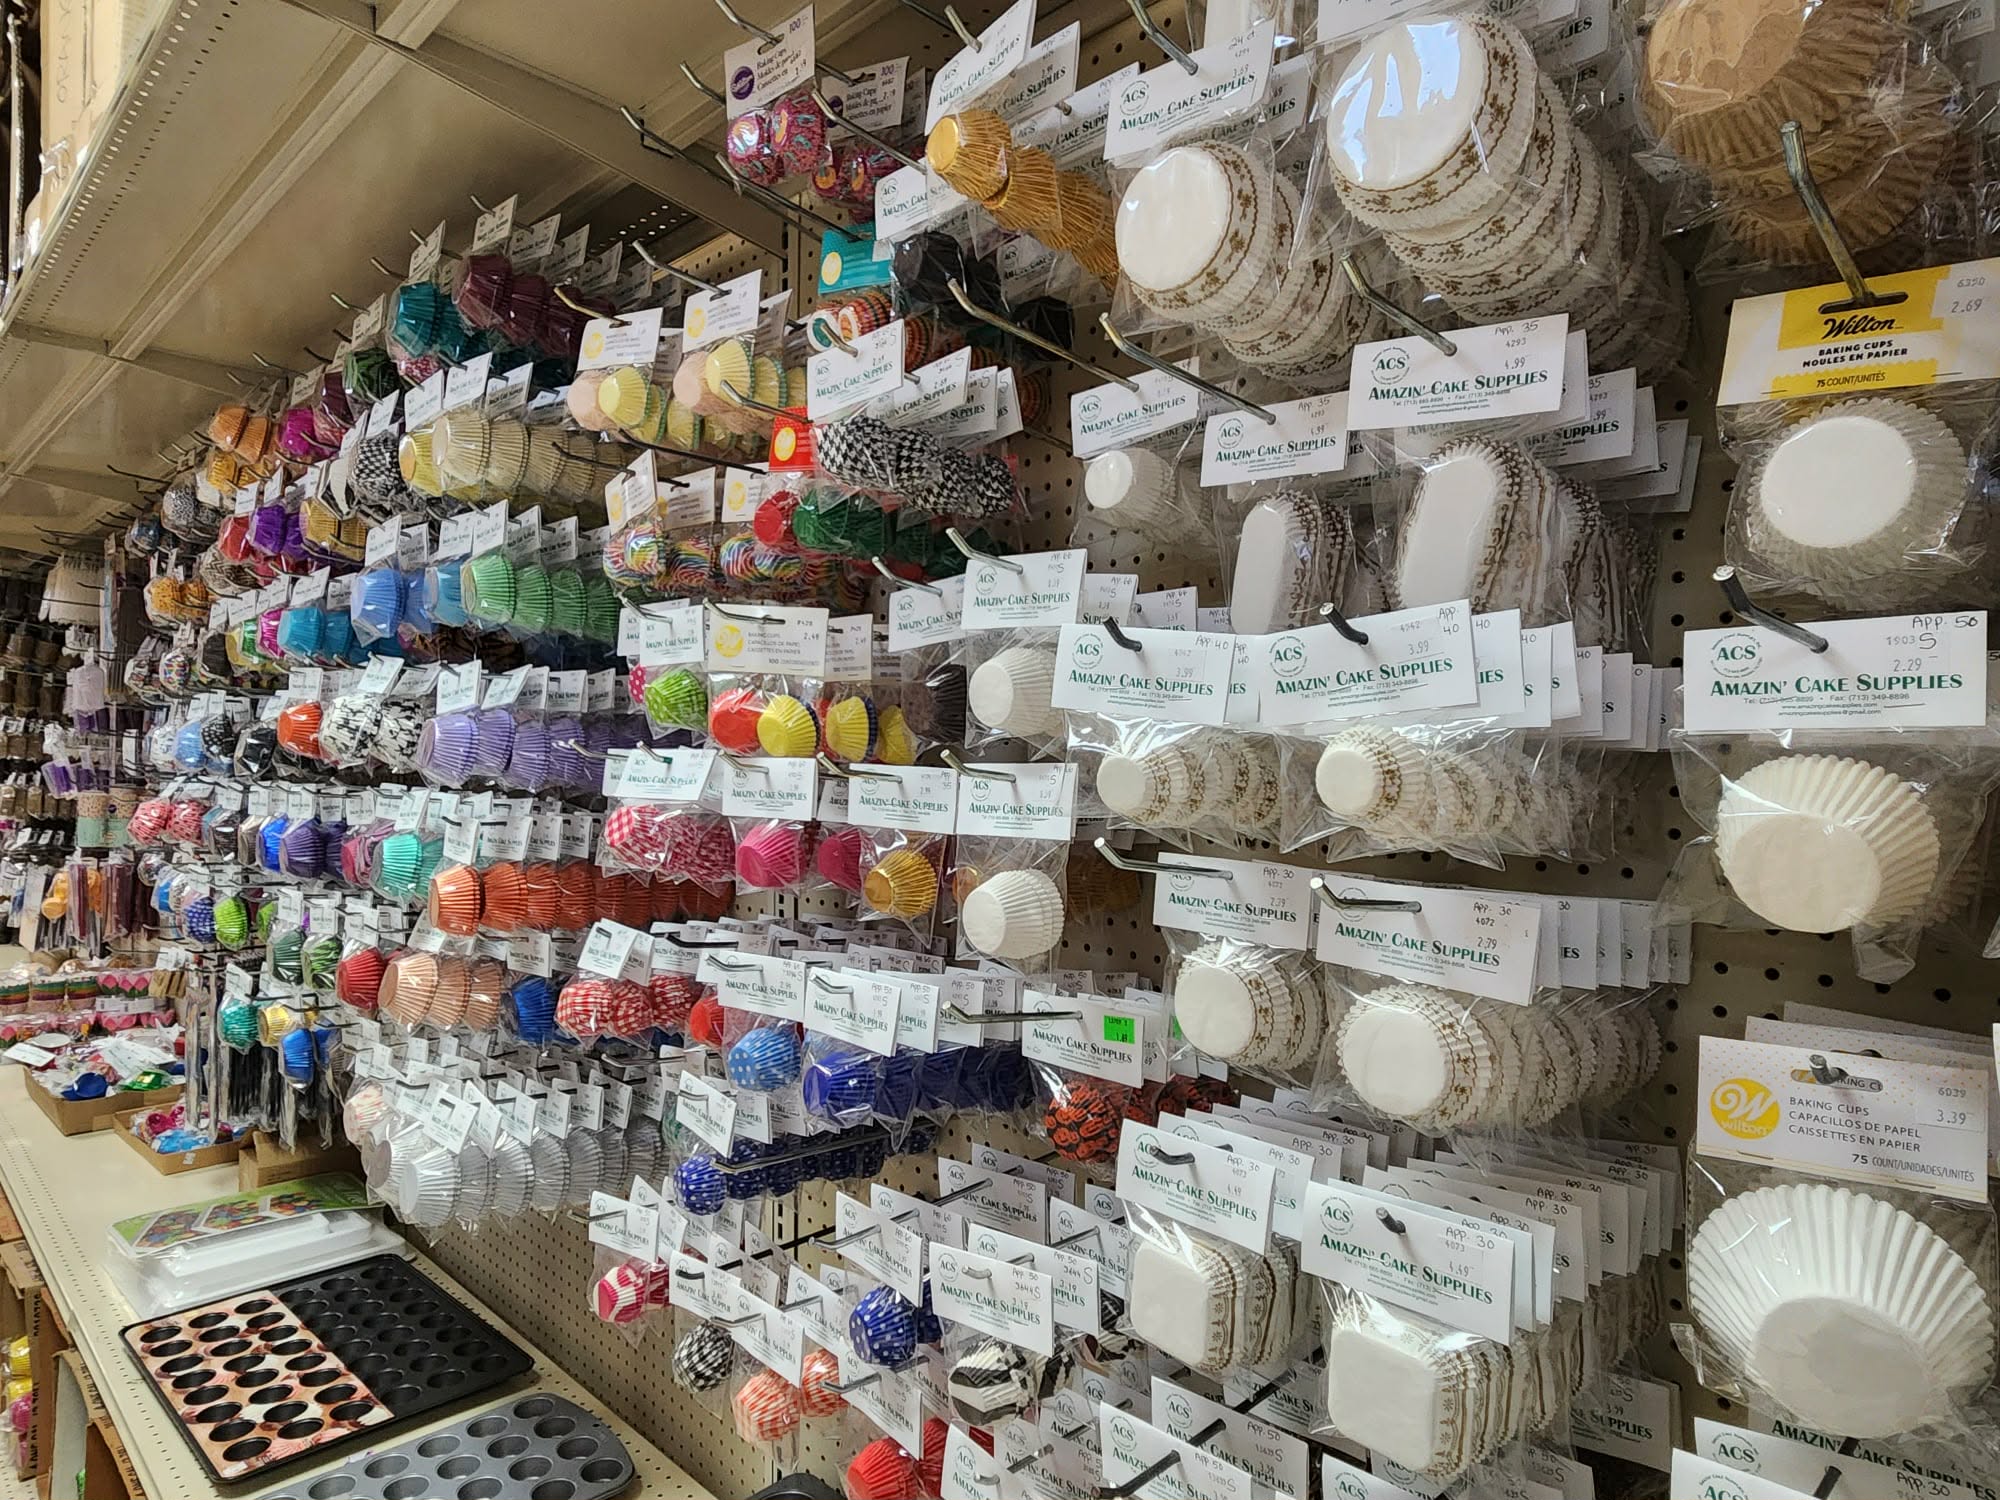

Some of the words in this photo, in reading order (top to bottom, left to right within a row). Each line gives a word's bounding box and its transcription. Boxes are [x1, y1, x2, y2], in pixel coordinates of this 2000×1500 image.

[1123, 87, 1147, 104] ACS
[1167, 95, 1195, 115] CAKE
[1199, 73, 1255, 101] SUPPLIES
[1951, 299, 1982, 313] 2.69
[1522, 320, 1539, 332] 35
[1821, 314, 1896, 339] Wilton
[1819, 345, 1860, 356] BAKING
[1864, 339, 1893, 350] CUPS
[1376, 357, 1406, 370] ACS
[1802, 356, 1844, 368] MOULES
[1849, 352, 1864, 361] EN
[1867, 347, 1908, 360] PAPIER
[1369, 385, 1427, 400] AMAZIN'
[1431, 380, 1470, 395] CAKE
[1474, 370, 1549, 390] SUPPLIES
[1816, 378, 1826, 388] 75
[1827, 371, 1885, 387] COUNT/UNITÉS
[1080, 401, 1100, 414] ACS
[1141, 396, 1186, 415] SUPPLIES
[1219, 426, 1241, 442] ACS
[1257, 443, 1285, 458] CAKE
[1287, 436, 1336, 454] SUPPLIES
[977, 572, 996, 586] ACS
[1008, 592, 1031, 606] CAKE
[1032, 591, 1070, 604] SUPPLIES
[1475, 620, 1490, 631] 40
[1955, 615, 1978, 627] 50
[1444, 624, 1460, 635] 40
[1075, 643, 1101, 656] ACS
[1215, 641, 1229, 650] 40
[1717, 645, 1756, 661] ACS
[1274, 647, 1303, 663] ACS
[1893, 658, 1922, 672] 2.29
[1068, 669, 1116, 687] AMAZIN'
[1120, 674, 1151, 689] CAKE
[1155, 678, 1214, 695] SUPPLIES
[1275, 676, 1330, 695] AMAZIN'
[1336, 670, 1376, 686] CAKE
[1380, 658, 1453, 680] SUPPLIES
[1710, 680, 1787, 697] AMAZIN'
[1795, 676, 1849, 693] CAKE
[1856, 673, 1963, 691] SUPPLIES
[912, 799, 948, 812] SUPPLIES
[1002, 804, 1024, 815] CAKE
[1025, 806, 1063, 816] SUPPLIES
[1283, 869, 1294, 878] 30
[1168, 893, 1210, 908] AMAZIN'
[1214, 898, 1242, 913] CAKE
[1245, 903, 1297, 922] SUPPLIES
[1335, 922, 1387, 943] AMAZIN'
[1392, 932, 1428, 951] CAKE
[1432, 940, 1500, 966] SUPPLIES
[859, 1012, 888, 1031] SUPPLIES
[1067, 1036, 1089, 1051] CAKE
[1090, 1043, 1133, 1064] SUPPLIES
[1790, 1097, 1832, 1111] BAKING
[1838, 1104, 1869, 1116] CUPS
[1789, 1111, 1862, 1130] CAPACILLOS
[1864, 1122, 1881, 1133] DE
[1884, 1125, 1921, 1138] PAPEL
[1936, 1110, 1966, 1126] 3.39
[1789, 1125, 1856, 1142] CAISSETTES
[1859, 1135, 1875, 1146] EN
[1879, 1138, 1920, 1152] PAPIER
[1318, 1145, 1332, 1156] 30
[1250, 1160, 1260, 1172] 30
[1289, 1155, 1300, 1166] 30
[1852, 1154, 1868, 1164] 75
[1177, 1179, 1204, 1199] CAKE
[1207, 1190, 1257, 1222] SUPPLIES
[1324, 1206, 1350, 1223] ACS
[1552, 1204, 1568, 1215] 30
[1477, 1235, 1495, 1249] 30
[940, 1259, 957, 1272] ACS
[1380, 1252, 1418, 1277] CAKE
[1422, 1266, 1493, 1304] SUPPLIES
[975, 1292, 999, 1310] CAKE
[1000, 1301, 1041, 1326] SUPPLIES
[1169, 1401, 1190, 1419] ACS
[1112, 1423, 1134, 1442] ACS
[1268, 1428, 1281, 1441] 50
[1718, 1444, 1755, 1463] ACS
[1210, 1444, 1239, 1466] CAKE
[1242, 1460, 1295, 1495] SUPPLIES
[1928, 1481, 1950, 1496] 30
